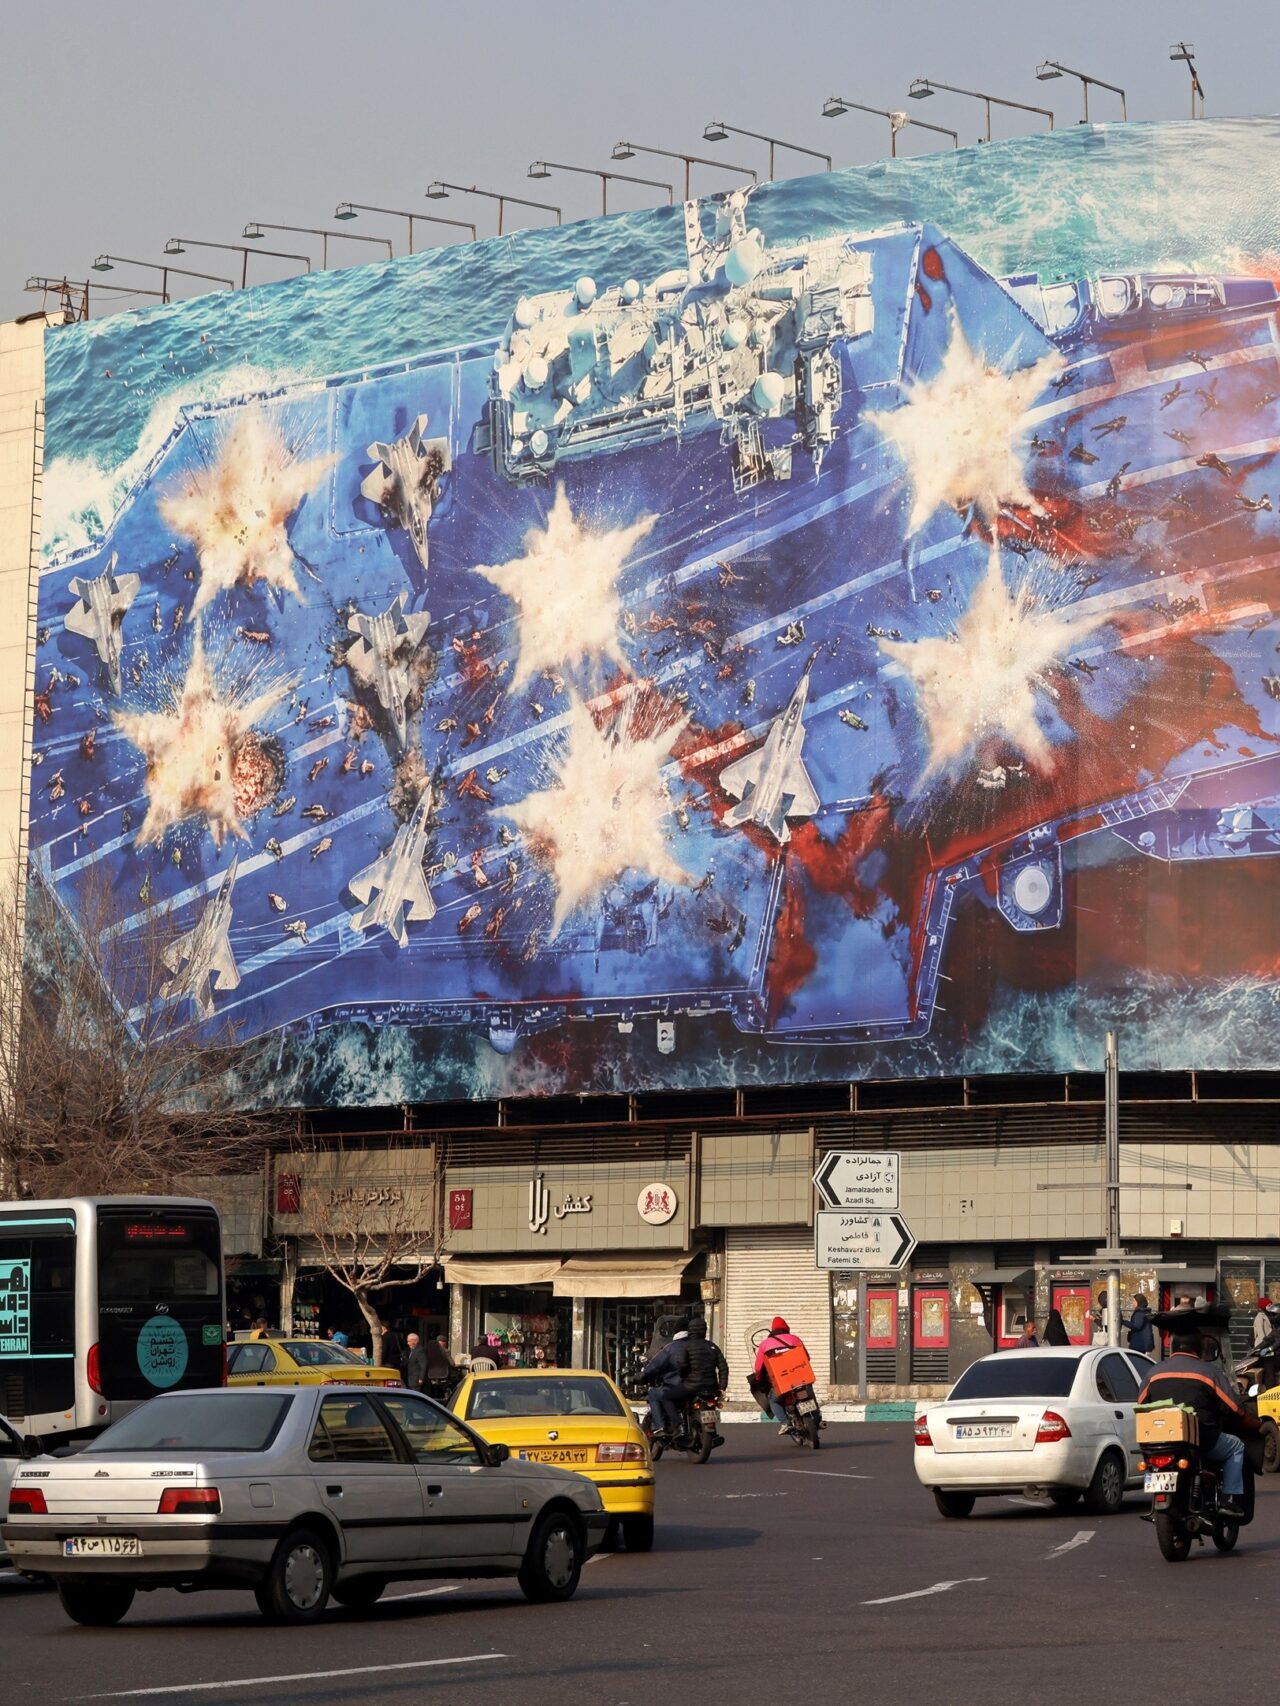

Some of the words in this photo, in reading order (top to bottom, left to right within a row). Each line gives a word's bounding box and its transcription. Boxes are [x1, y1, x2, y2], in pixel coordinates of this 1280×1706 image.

[845, 1157, 882, 1167] جمالزاده
[855, 1171, 882, 1183] آزادی
[553, 1194, 592, 1219] کفش
[840, 1216, 870, 1226] کشاورز
[841, 1232, 869, 1242] فاطمی
[828, 1256, 851, 1264] Fatemi
[0, 1337, 28, 1351] EHRAN
